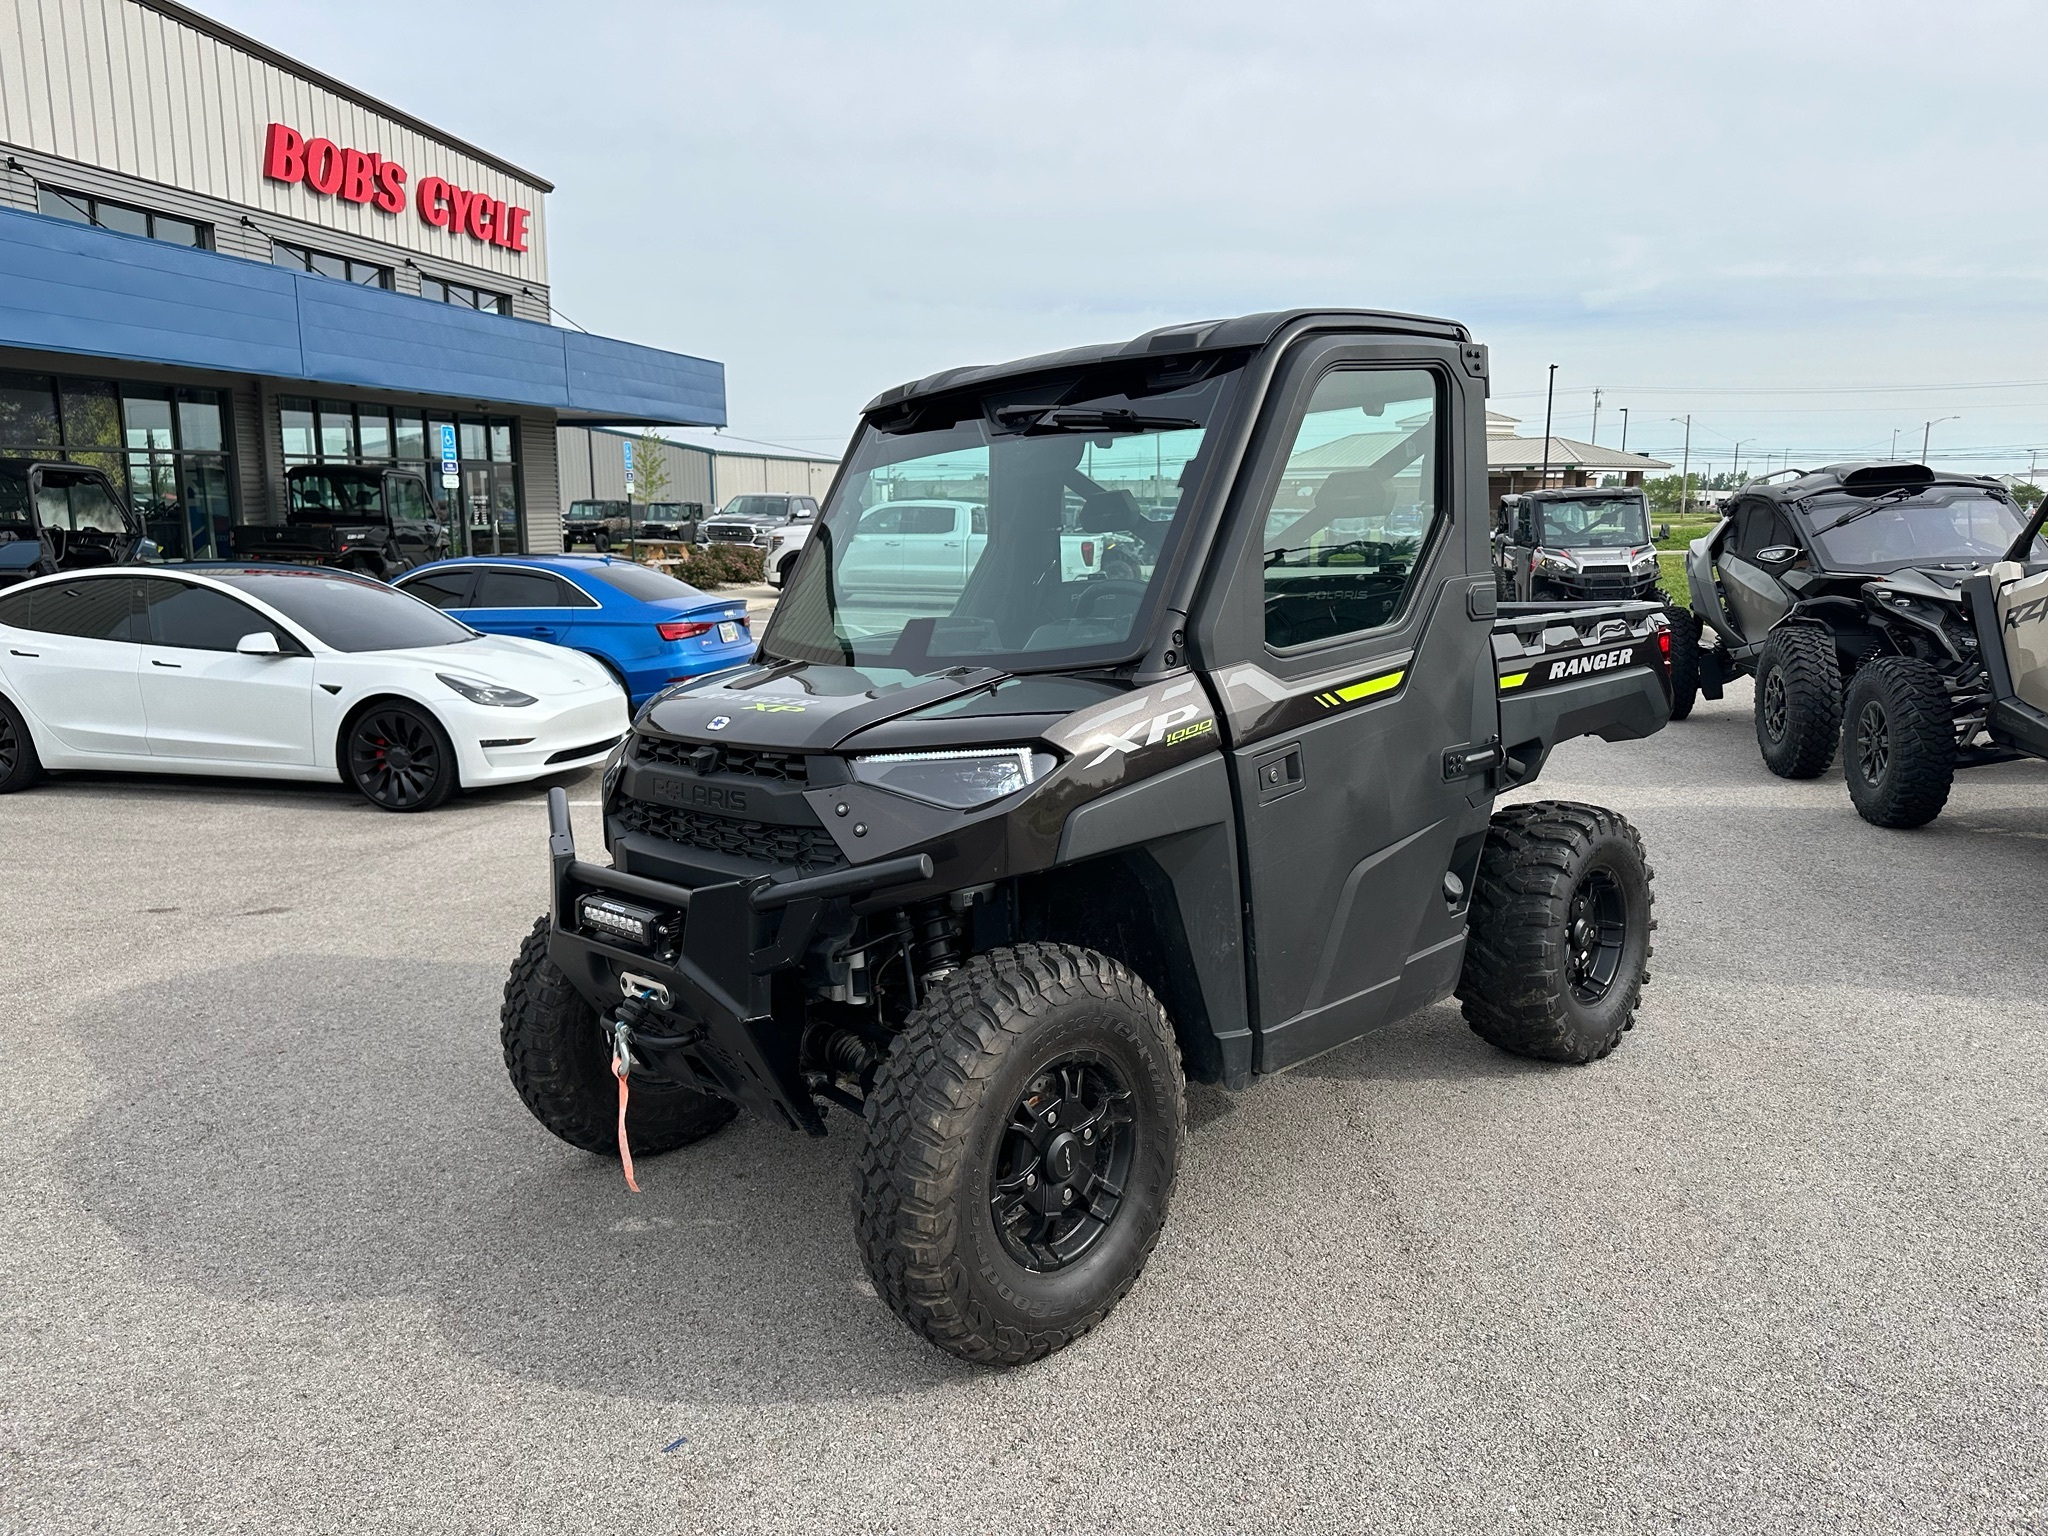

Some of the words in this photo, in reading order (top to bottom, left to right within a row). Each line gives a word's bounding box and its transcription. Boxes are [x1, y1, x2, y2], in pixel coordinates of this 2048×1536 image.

[263, 123, 407, 213] BOB'S
[416, 176, 532, 253] CYCLE
[1307, 590, 1369, 600] POLARIS
[1548, 648, 1634, 681] RANGER
[740, 702, 807, 713] XP
[1082, 703, 1201, 771] XP
[1166, 718, 1213, 743] 1000
[652, 777, 748, 812] POLARIS
